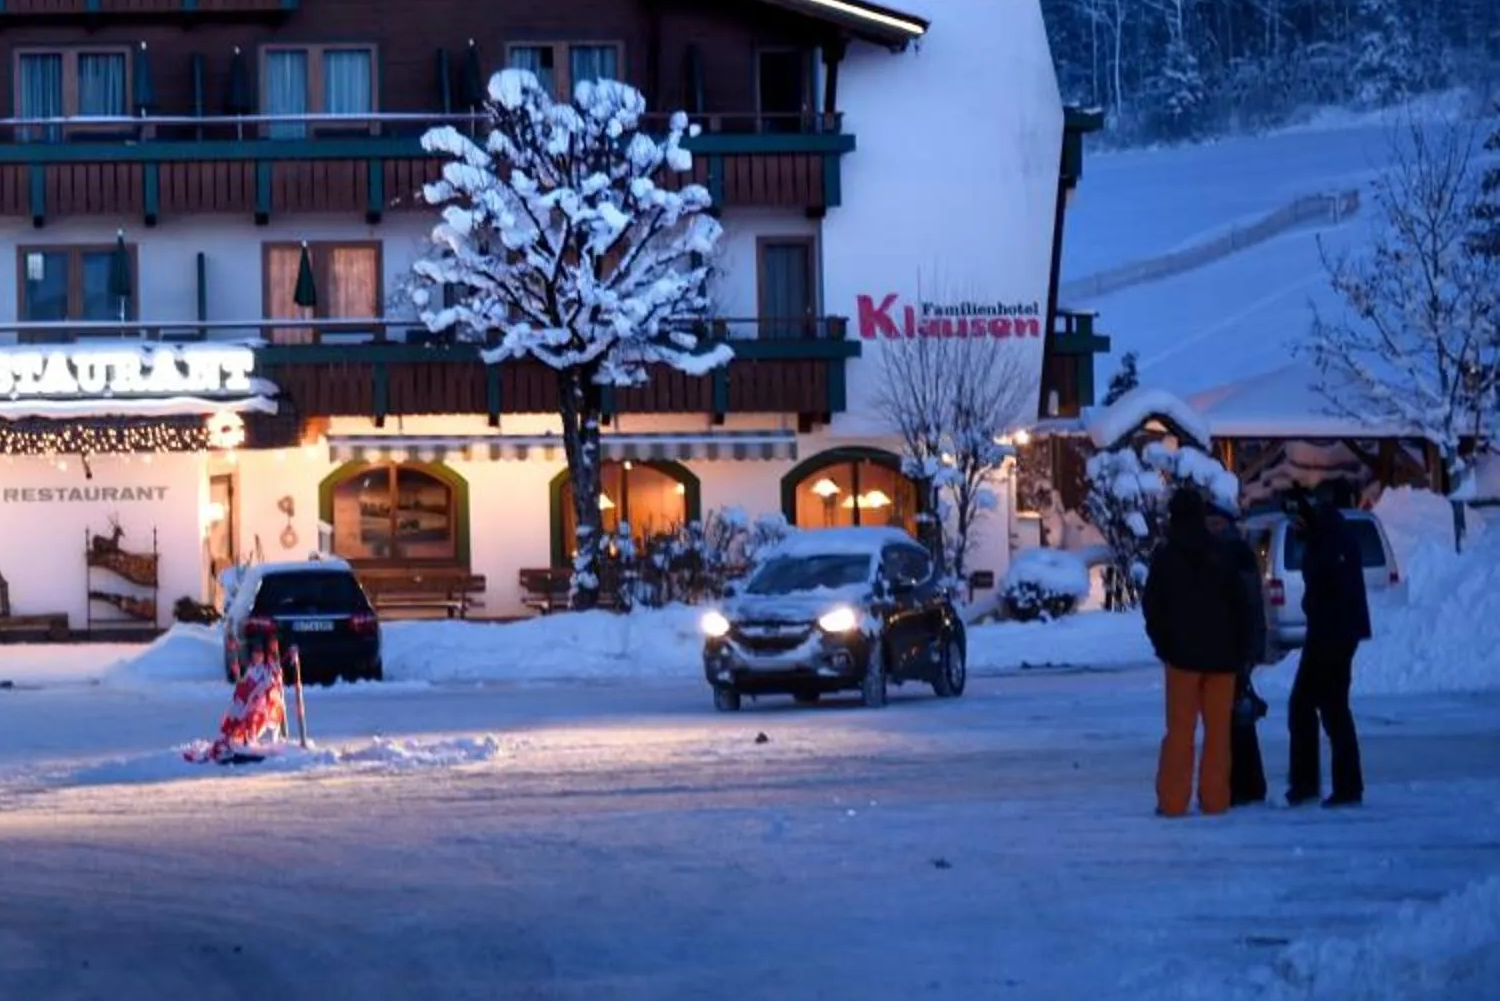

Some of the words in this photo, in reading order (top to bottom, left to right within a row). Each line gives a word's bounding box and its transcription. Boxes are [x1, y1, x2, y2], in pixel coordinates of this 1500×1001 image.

[856, 293, 1041, 340] Klausen
[921, 300, 1040, 317] Familienhotel
[3, 486, 168, 503] RESTAURANT
